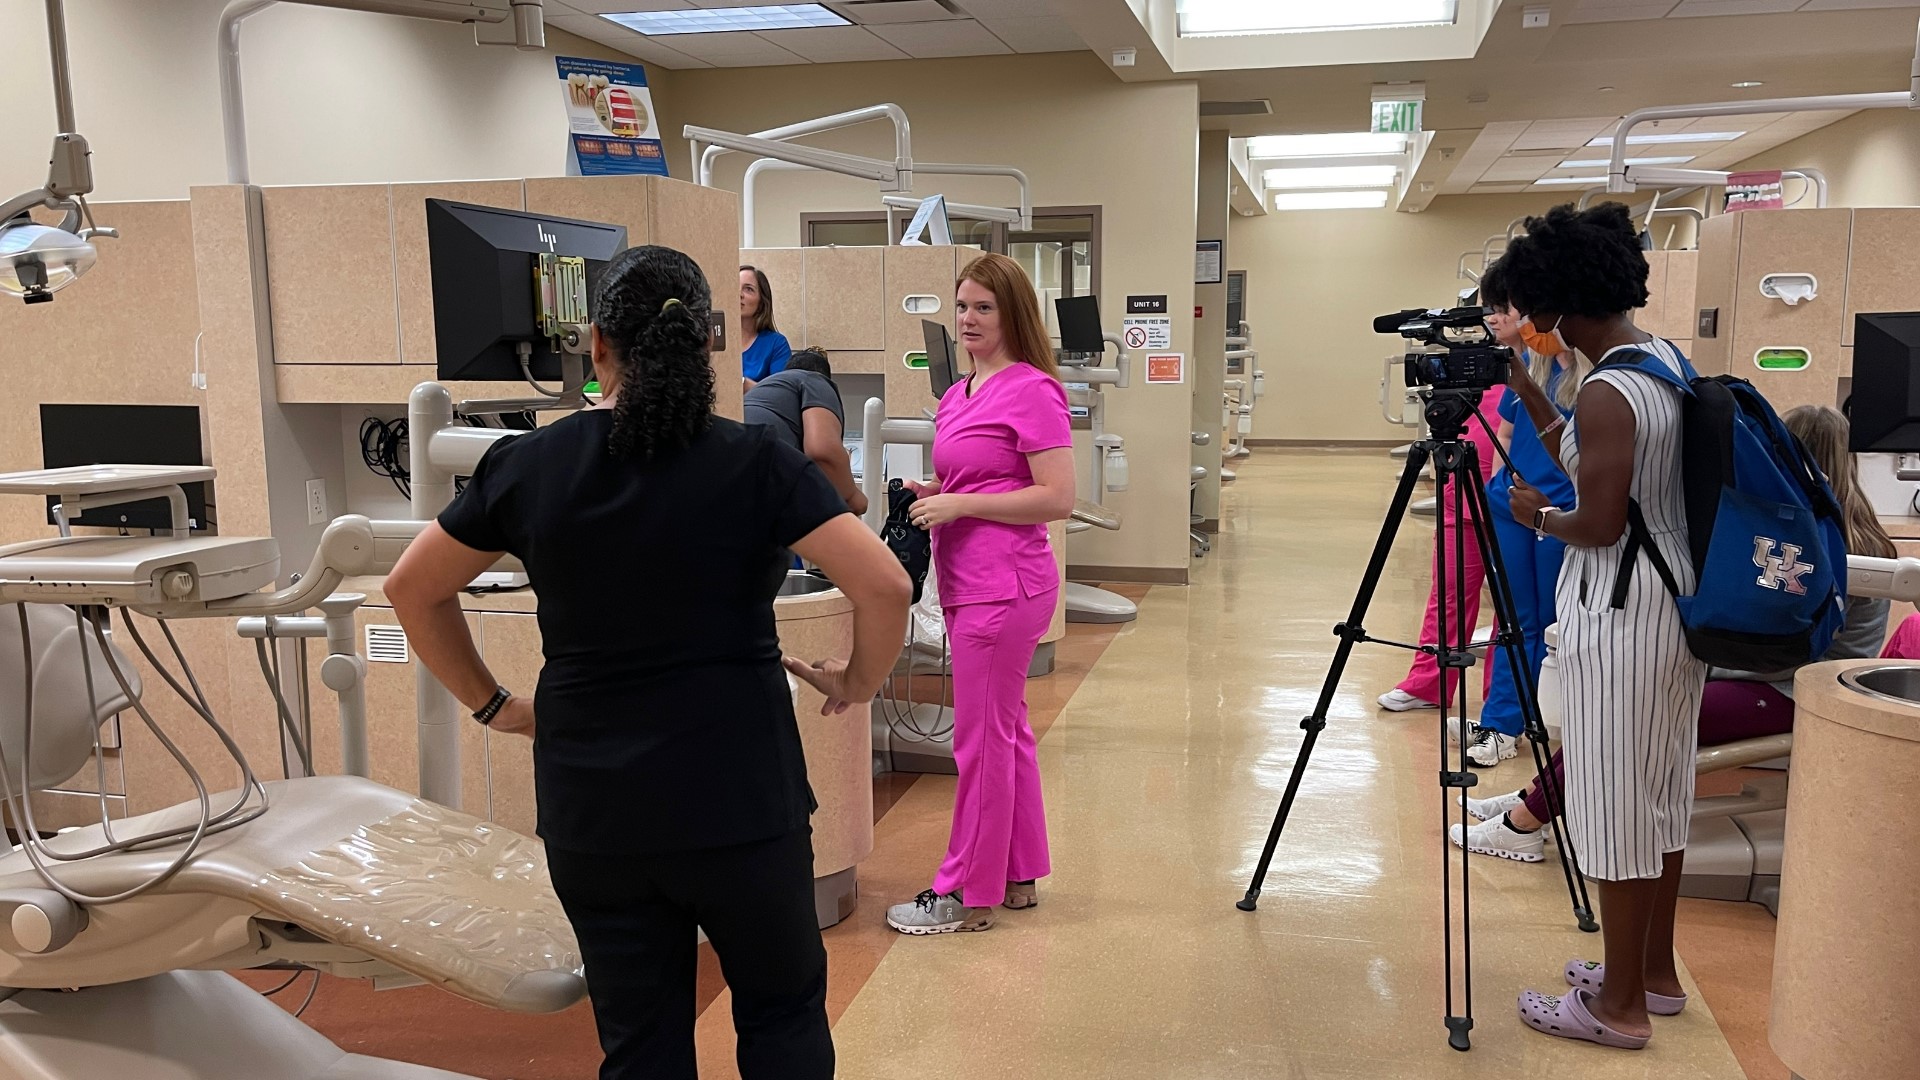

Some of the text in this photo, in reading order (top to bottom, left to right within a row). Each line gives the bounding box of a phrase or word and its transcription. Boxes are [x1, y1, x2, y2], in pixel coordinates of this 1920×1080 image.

[1379, 102, 1417, 132] EXIT
[537, 223, 557, 253] hp
[1752, 535, 1815, 596] UK
